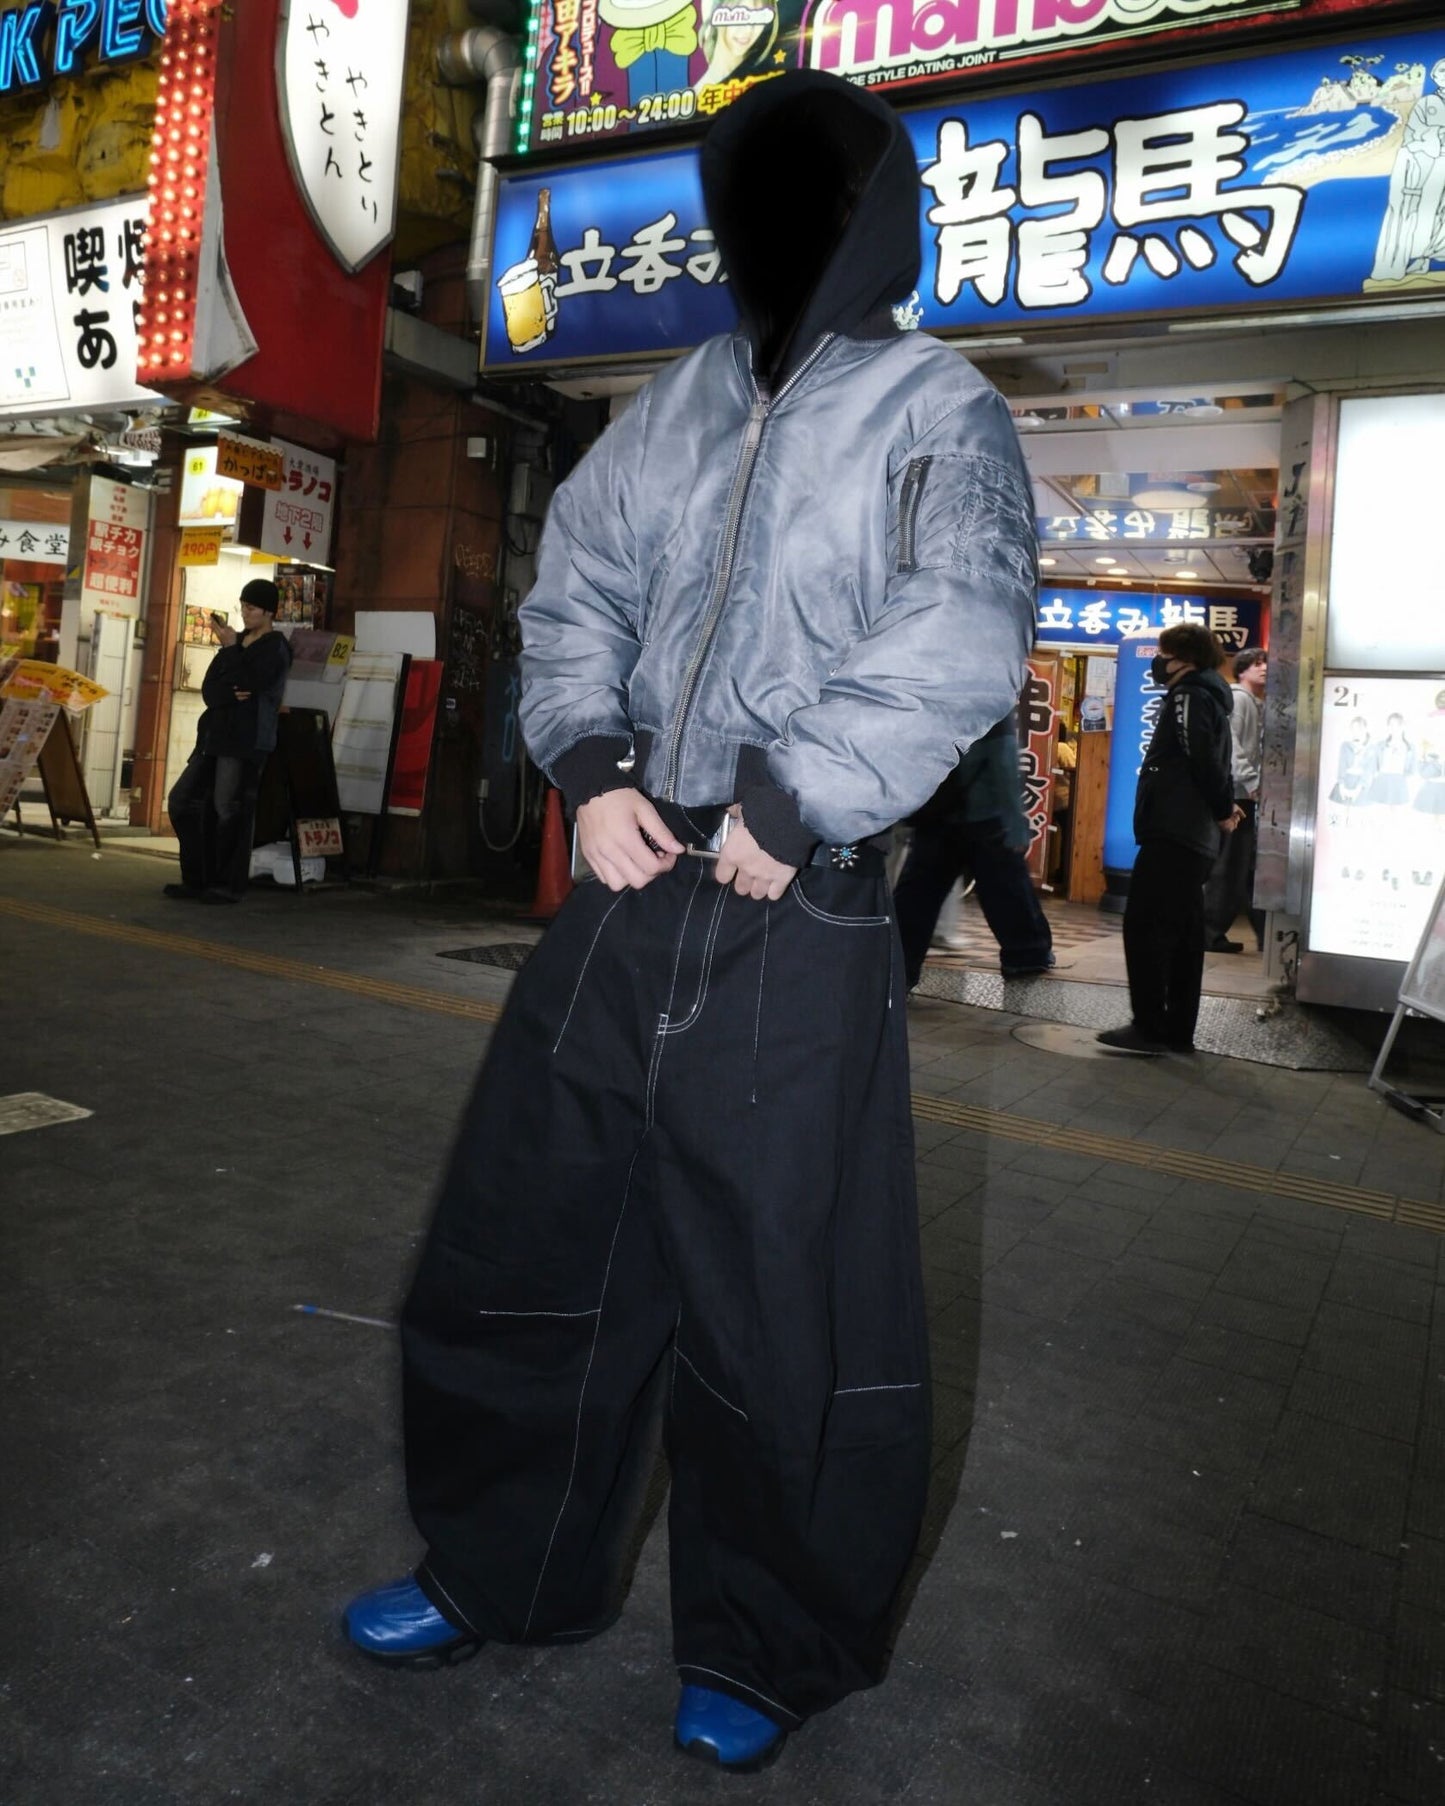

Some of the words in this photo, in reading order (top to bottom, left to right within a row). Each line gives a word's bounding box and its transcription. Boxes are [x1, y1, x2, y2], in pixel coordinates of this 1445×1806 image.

[306, 13, 344, 179] やきとん
[867, 67, 906, 85] STYLE
[907, 58, 956, 78] DATING
[956, 50, 998, 69] JOINT
[345, 65, 379, 224] やきとり
[920, 98, 1307, 311] 龍馬
[282, 469, 332, 503] ラノコ
[332, 643, 349, 661] B2
